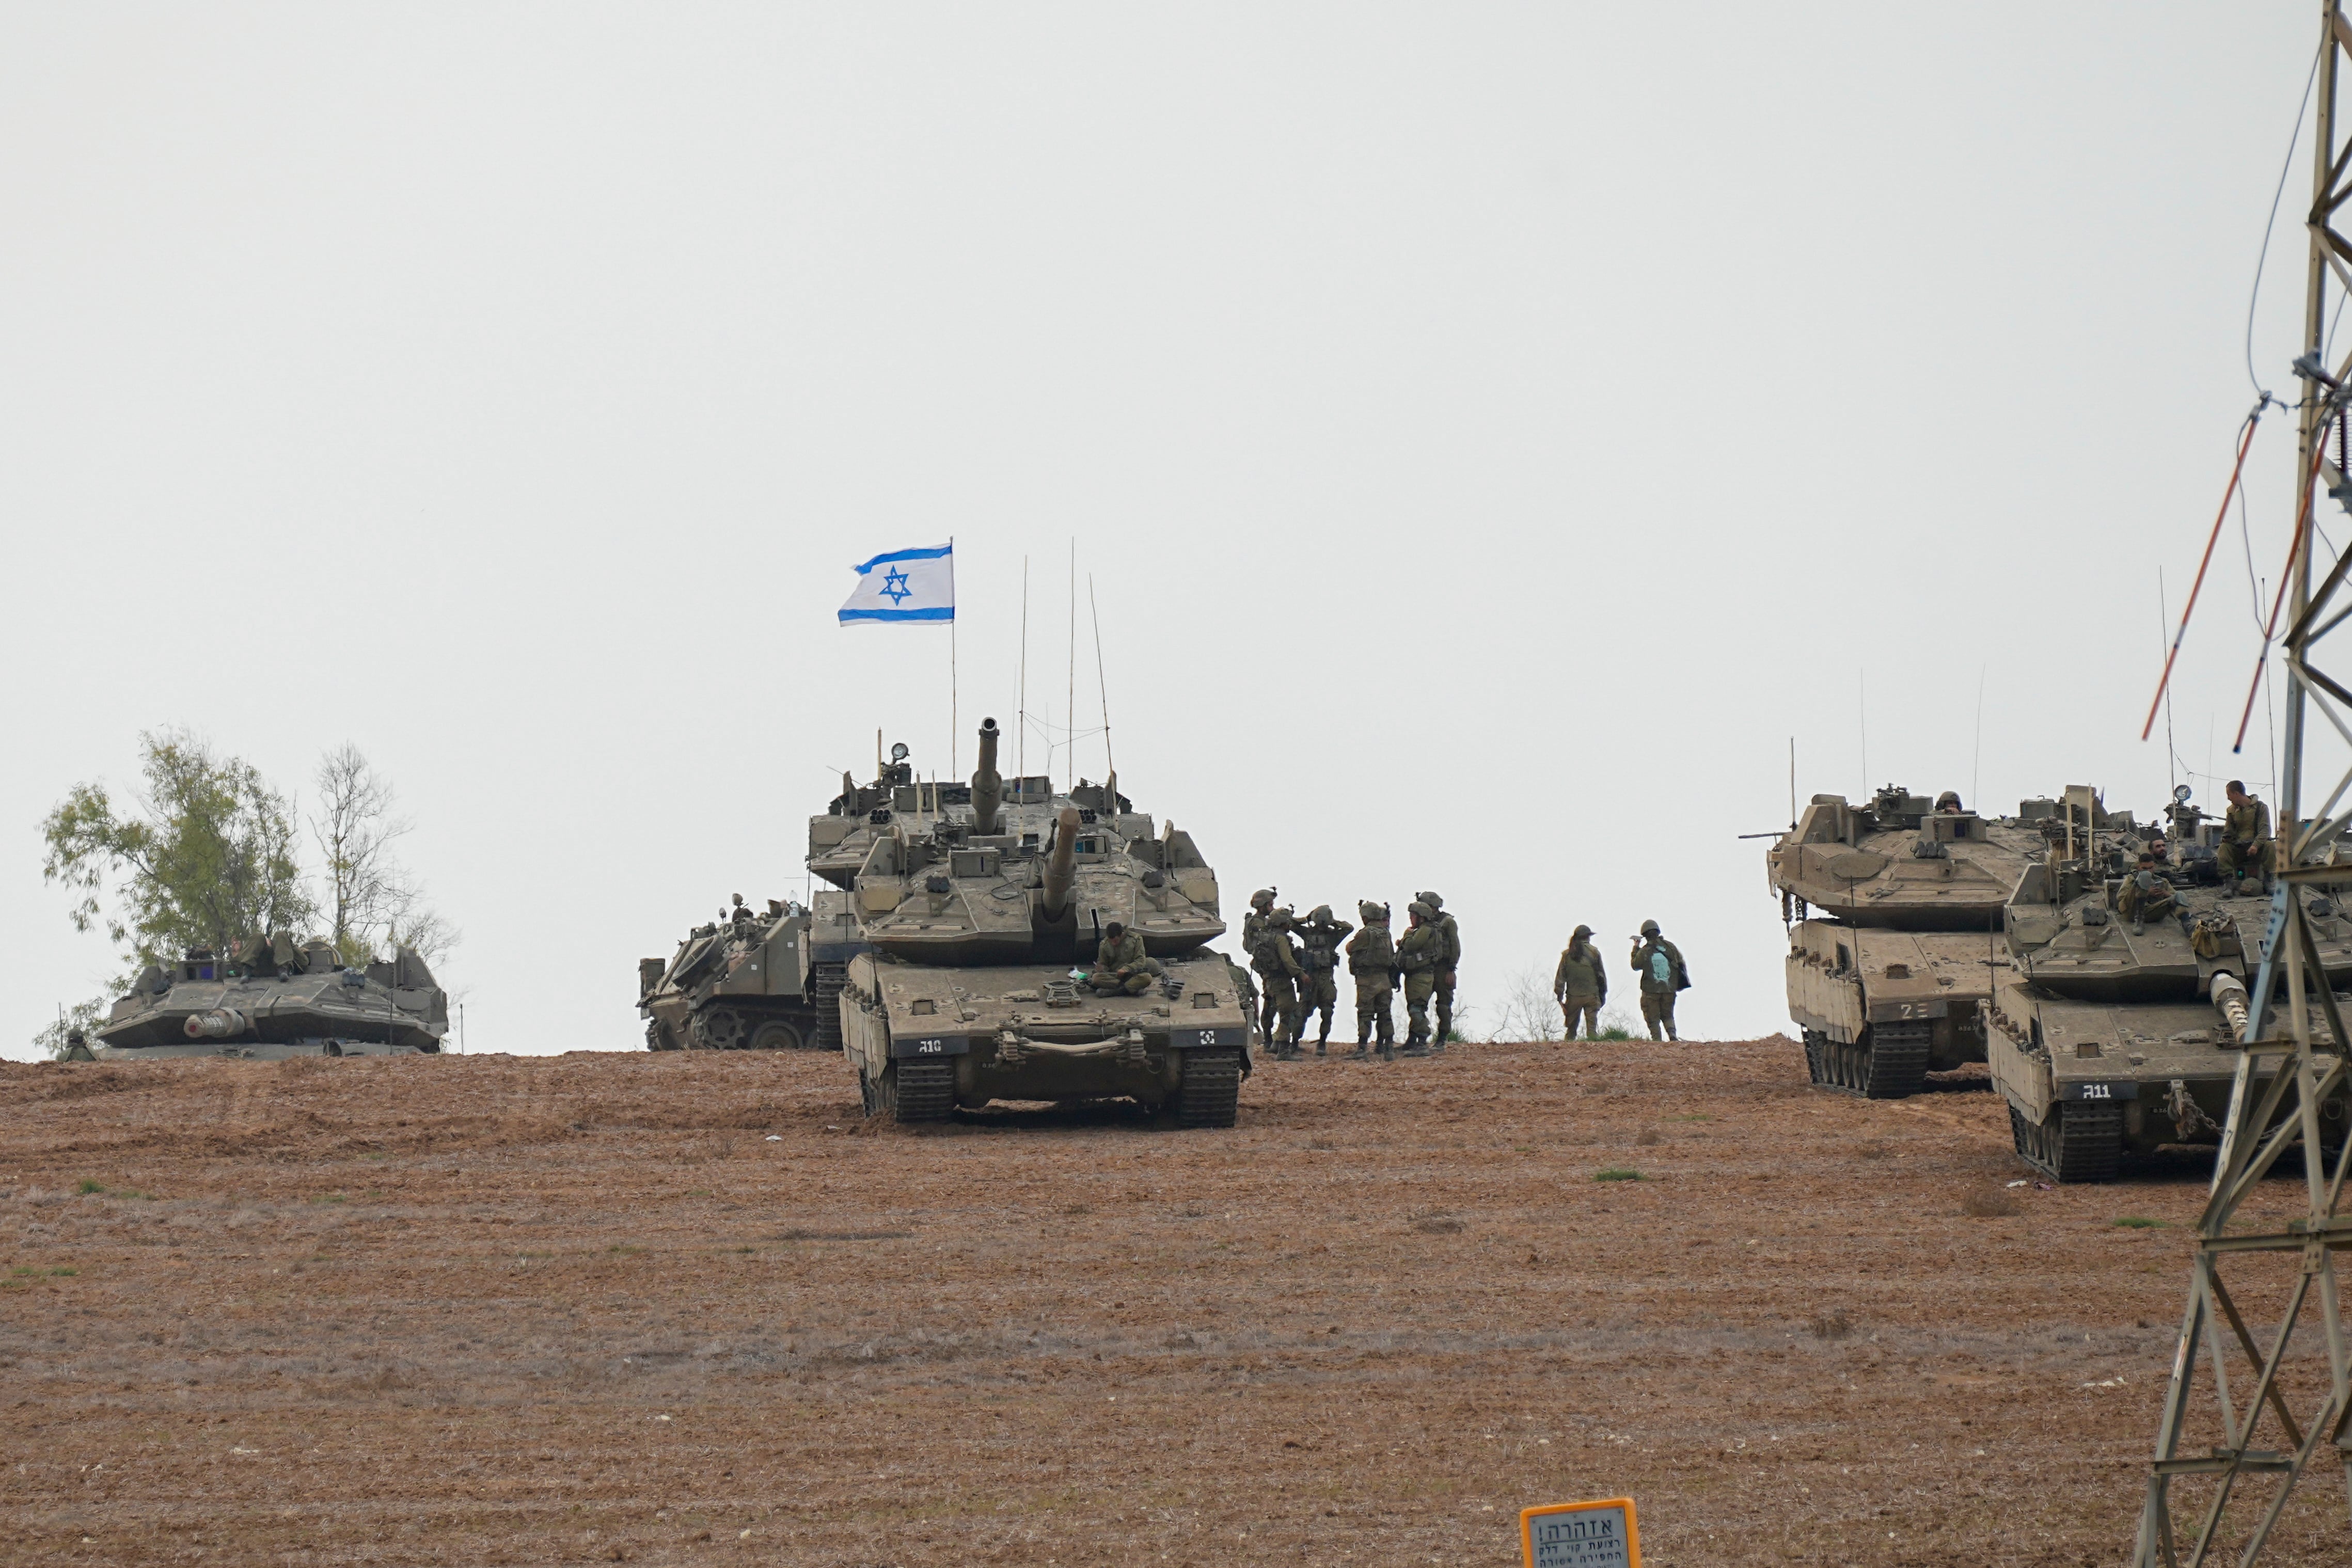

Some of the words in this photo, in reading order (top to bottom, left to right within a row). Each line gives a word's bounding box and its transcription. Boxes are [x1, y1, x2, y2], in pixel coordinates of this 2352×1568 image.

[1588, 1540, 1620, 1550] רצועת
[1539, 1544, 1558, 1558] דלק
[1539, 1557, 1572, 1568] אסורה
[1580, 1552, 1621, 1563] החפירה
